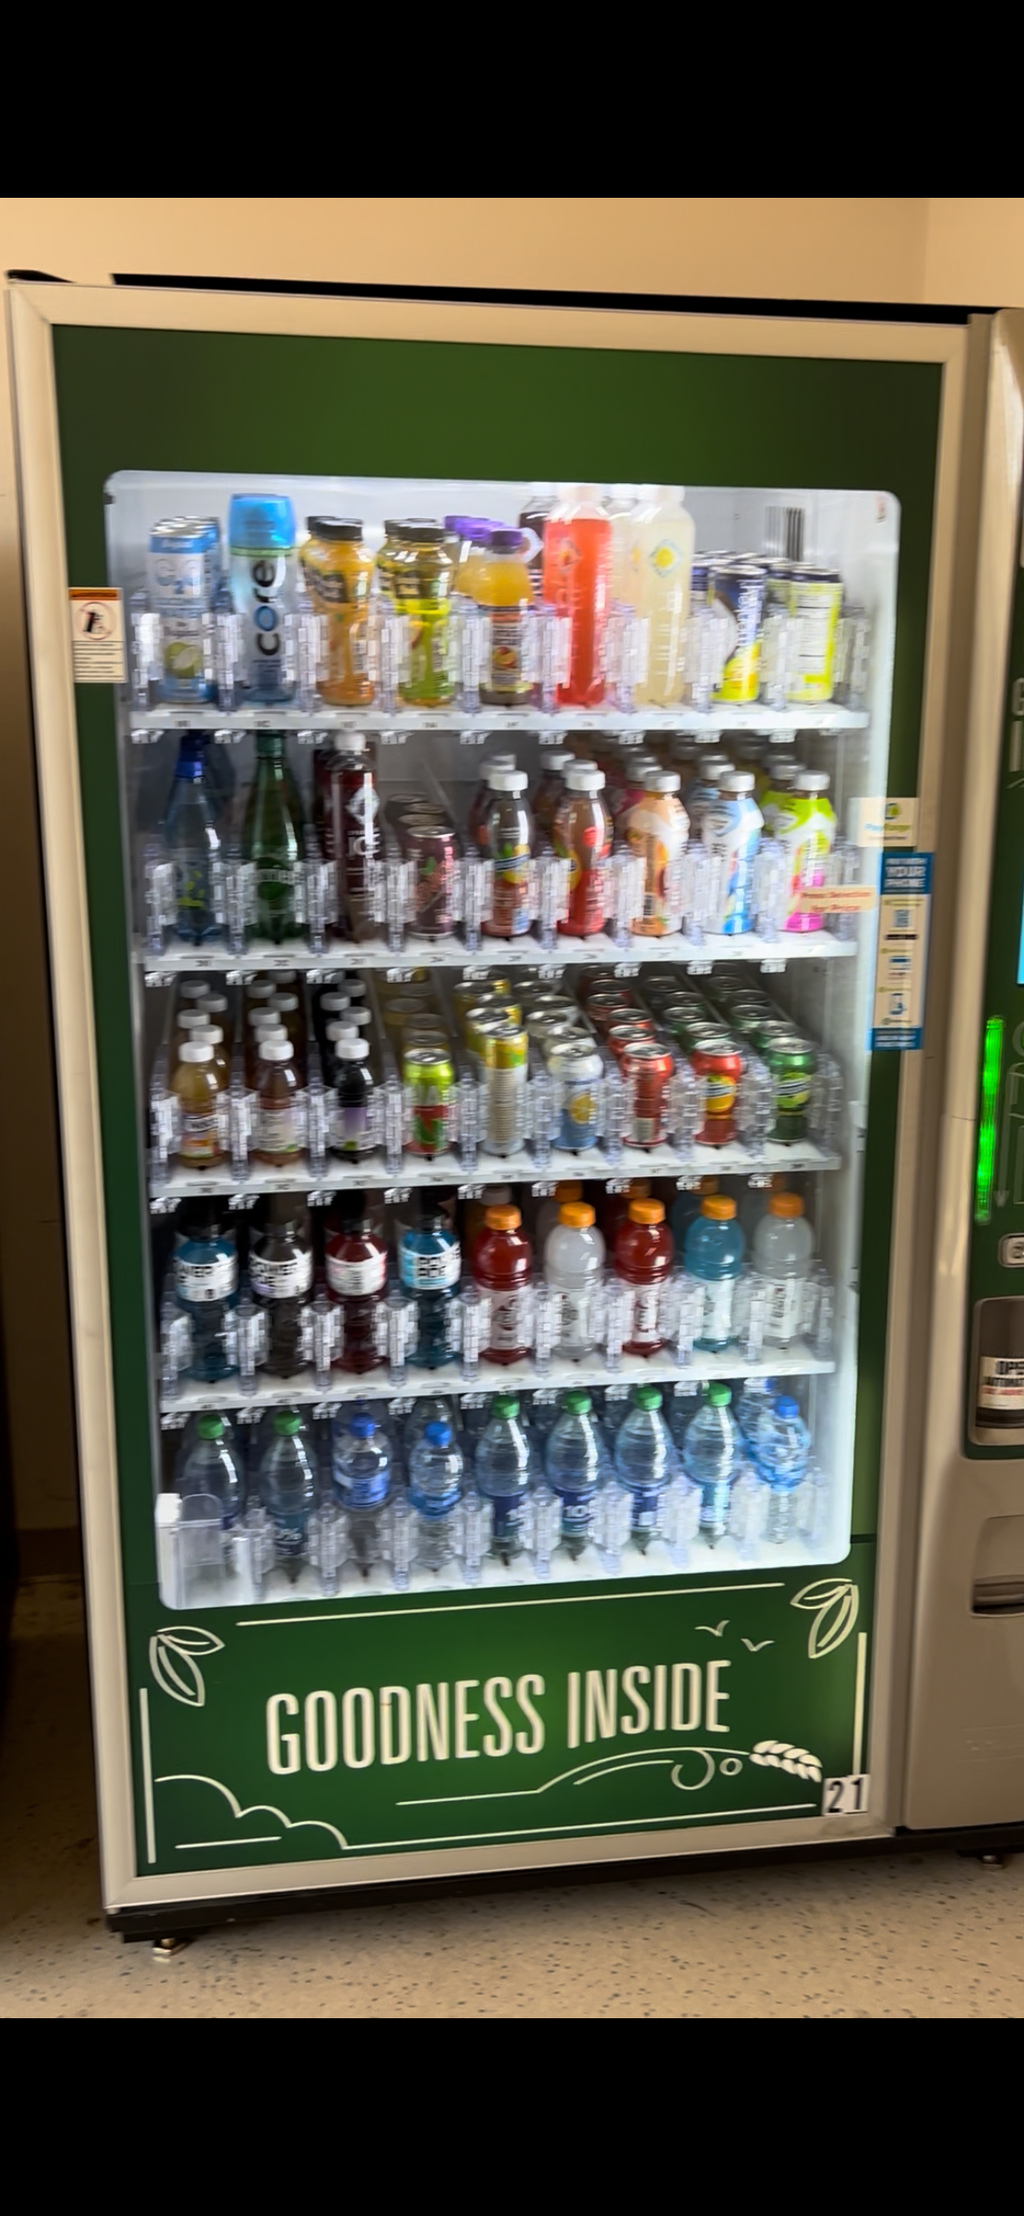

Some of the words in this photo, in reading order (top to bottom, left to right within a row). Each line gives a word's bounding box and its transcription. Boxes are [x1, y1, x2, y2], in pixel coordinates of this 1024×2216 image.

[252, 560, 281, 656] core
[265, 1673, 546, 1776] GOODNESS
[567, 1659, 732, 1749] INSIDE
[827, 1777, 864, 1814] 21
